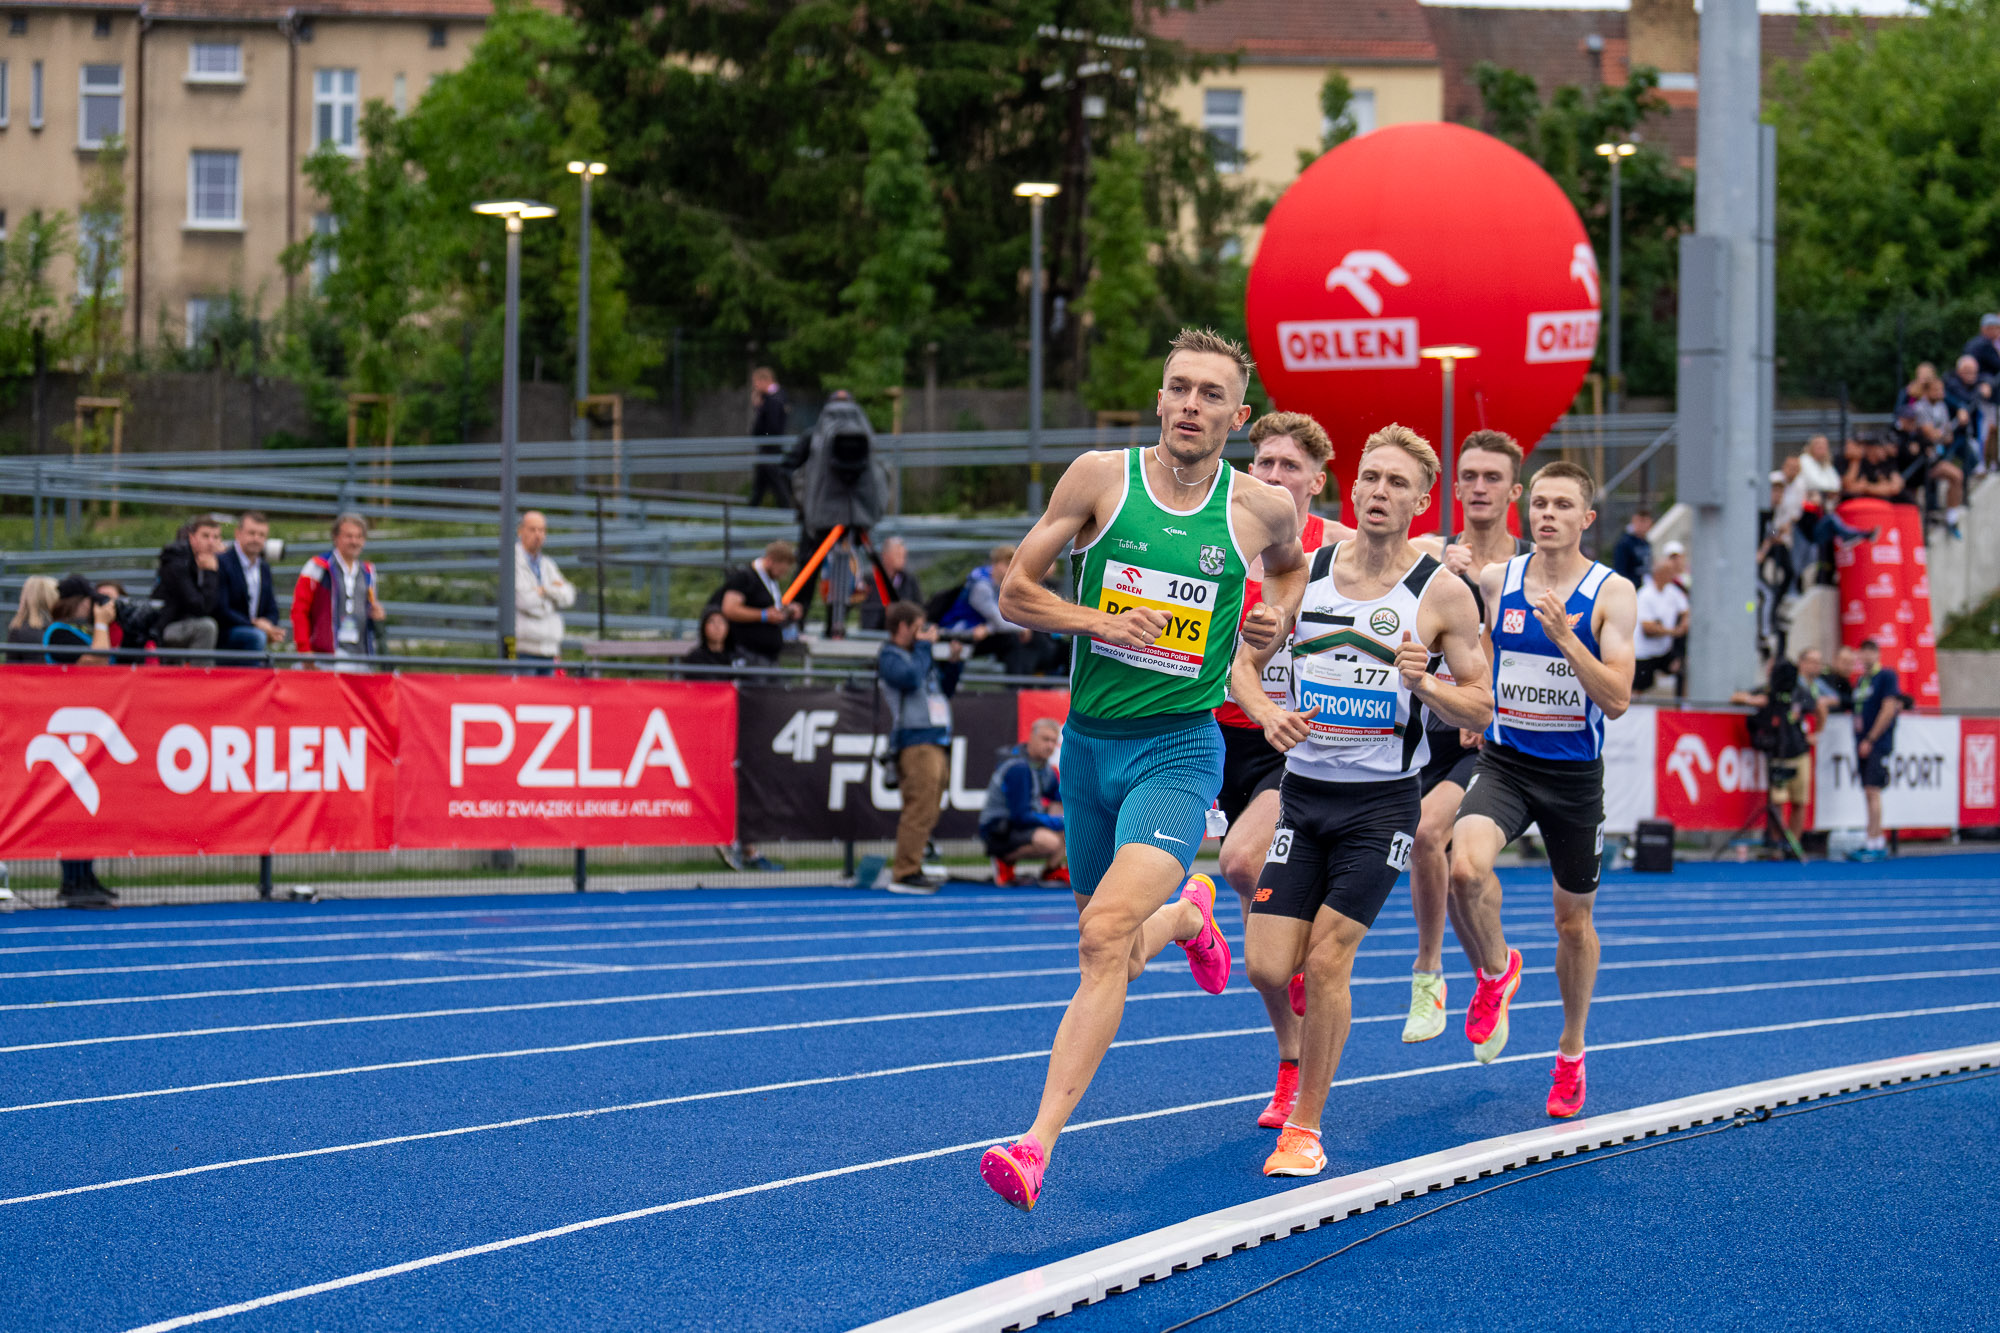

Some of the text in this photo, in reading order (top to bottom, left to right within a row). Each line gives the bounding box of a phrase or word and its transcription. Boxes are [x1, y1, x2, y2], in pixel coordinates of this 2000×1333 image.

[1288, 329, 1404, 361] ORLEN
[1116, 583, 1142, 595] ORLEN
[1167, 580, 1207, 604] 100
[1095, 644, 1125, 658] GORZÓW
[1126, 653, 1178, 670] WIELKOPOLSKI
[1178, 664, 1196, 673] 2023
[1170, 653, 1190, 661] Polski
[1353, 667, 1390, 686] 177
[1303, 690, 1391, 719] OSTROWSKI
[1501, 683, 1581, 707] WYDERKA
[772, 710, 839, 762] 4F
[1328, 726, 1363, 735] Mistrzostwa
[450, 704, 691, 787] PZLA
[157, 724, 368, 794] ORLEN
[449, 800, 502, 817] POLSKI
[576, 800, 627, 816] LEKKIEJ
[629, 800, 692, 816] ATLETYKI
[1392, 838, 1411, 866] 16
